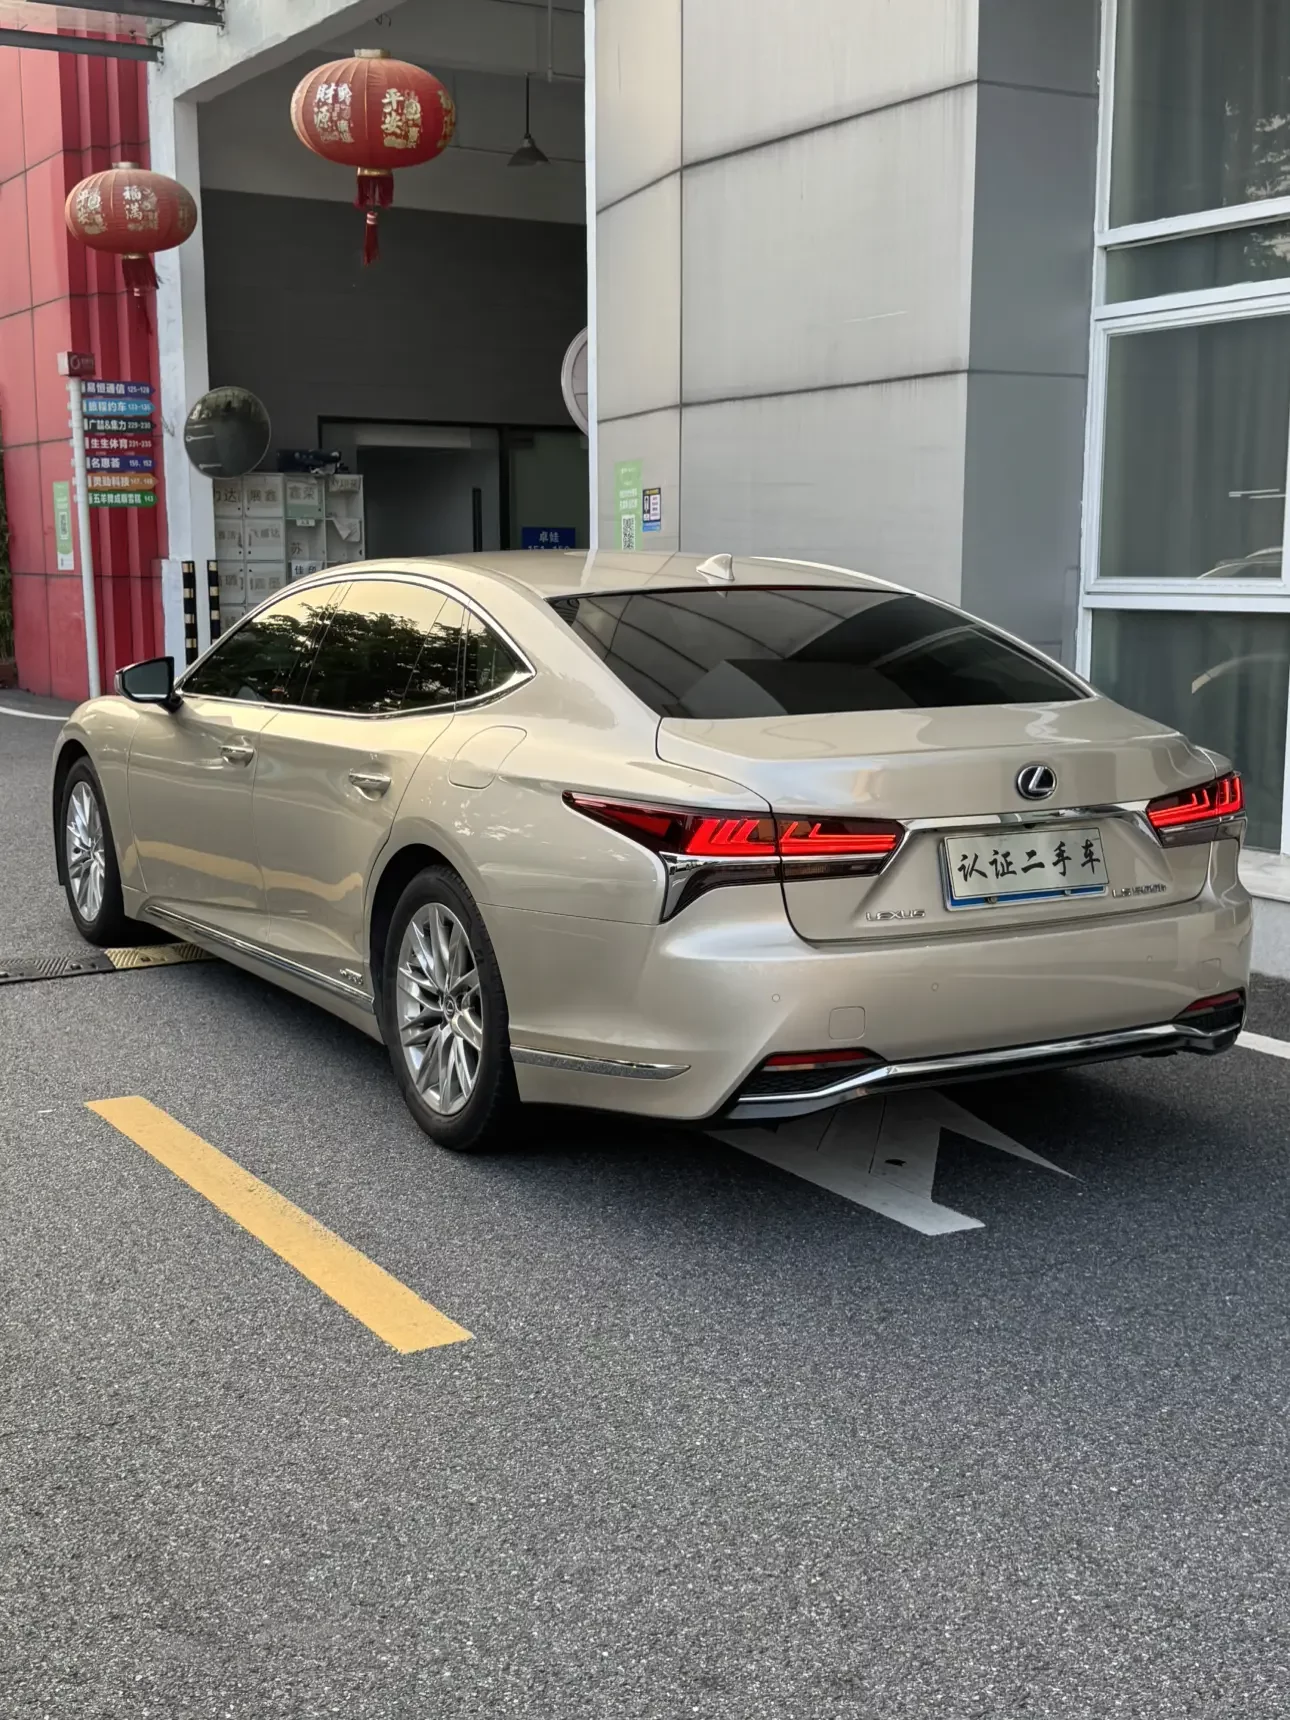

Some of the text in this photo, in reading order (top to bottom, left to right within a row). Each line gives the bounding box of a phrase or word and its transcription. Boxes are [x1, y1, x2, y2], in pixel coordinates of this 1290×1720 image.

[90, 438, 128, 449] 生生体育
[958, 839, 1100, 882] 认证二手车
[866, 909, 925, 921] LEXUS
